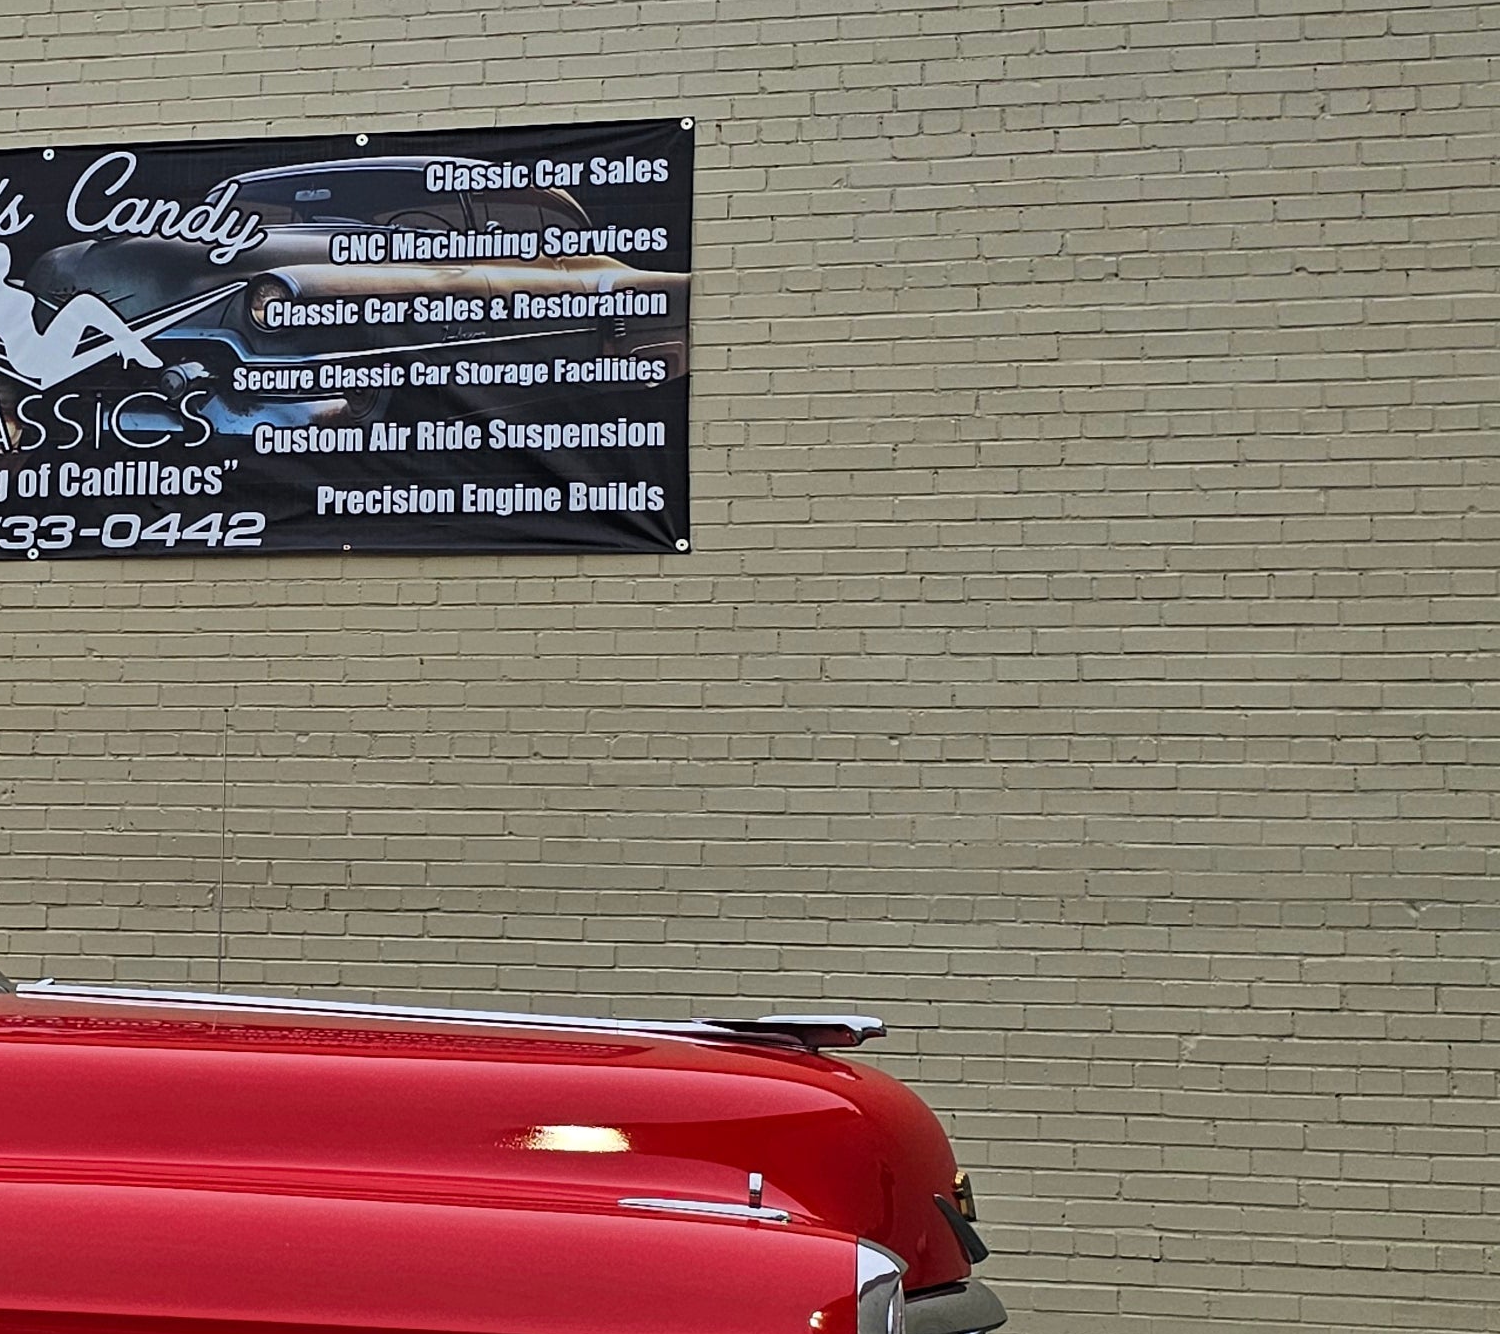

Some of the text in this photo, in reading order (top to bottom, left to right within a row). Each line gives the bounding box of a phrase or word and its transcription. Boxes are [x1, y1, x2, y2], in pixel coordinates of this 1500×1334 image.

[426, 155, 669, 192] Classic Car Sales
[67, 151, 265, 264] Candy
[332, 225, 668, 263] CNC Machining Services
[266, 293, 667, 327] Classic Car Sales & Restoration
[233, 358, 666, 390] Secure Classic Car Storage Facilities
[255, 419, 665, 454] Custom Air Ride Suspension
[18, 464, 51, 497] of
[317, 481, 664, 516] Precision Engine Builds
